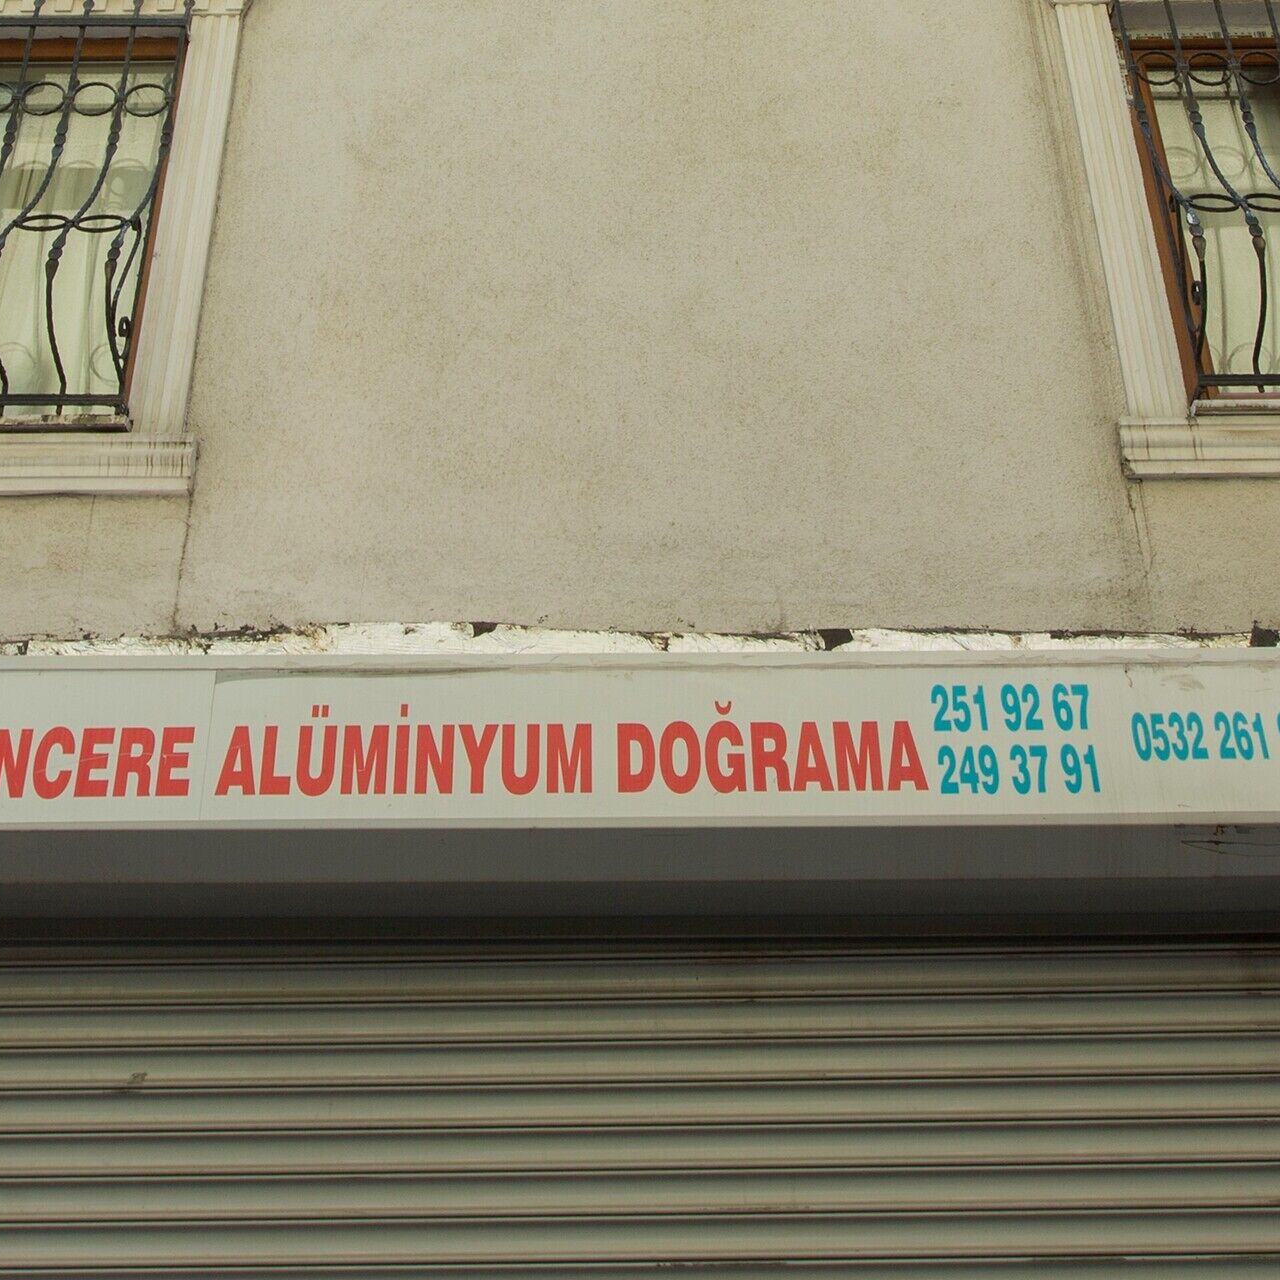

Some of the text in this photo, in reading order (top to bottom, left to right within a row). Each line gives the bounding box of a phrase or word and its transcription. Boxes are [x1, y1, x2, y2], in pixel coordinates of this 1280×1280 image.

[930, 684, 1090, 732] 251 92 67
[215, 704, 593, 797] ALÜMİNYUM
[616, 700, 930, 793] DOĞRAMA
[1131, 712, 1209, 762] 0532
[1214, 712, 1270, 761] 261
[936, 744, 1101, 795] 249 37 91
